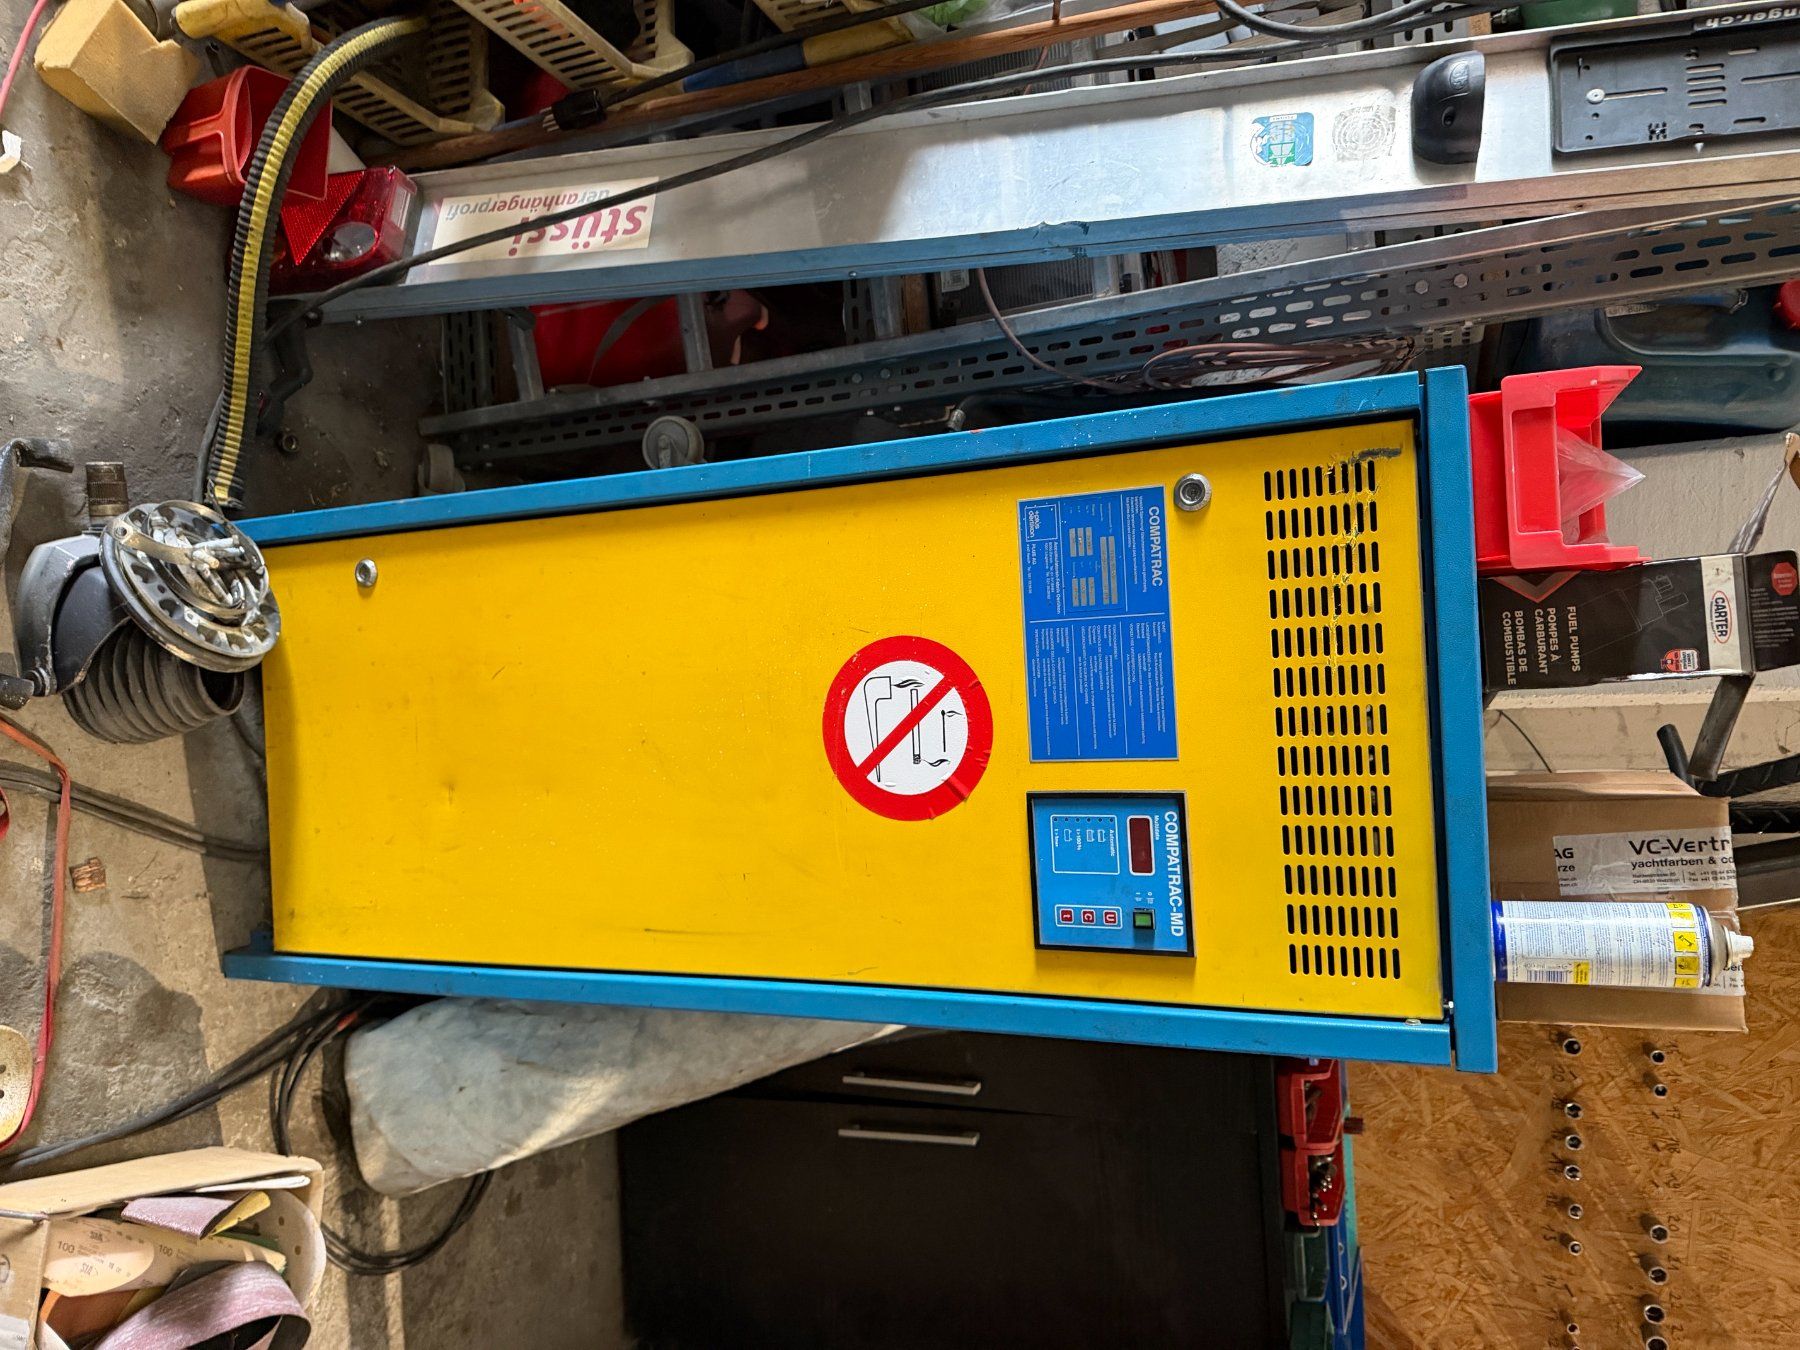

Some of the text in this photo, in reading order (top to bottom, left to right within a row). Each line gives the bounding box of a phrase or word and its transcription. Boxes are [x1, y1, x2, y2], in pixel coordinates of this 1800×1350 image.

[508, 205, 648, 257] stüssi
[1149, 506, 1163, 587] COMPATRAC
[1514, 610, 1528, 672] BOMBAS DE
[1534, 608, 1548, 675] CARBURANT
[1547, 608, 1561, 662] POMPES À
[1566, 606, 1581, 672] FUEL PUMPS
[1713, 597, 1729, 638] CARTER
[1502, 611, 1517, 685] COMBUSTIBLE
[1628, 836, 1729, 855] VC-Vertr
[1631, 858, 1703, 870] yachtfarben
[1164, 811, 1184, 936] COMPATRAC-MD
[1085, 913, 1092, 921] C
[58, 1240, 74, 1254] 100
[1668, 1215, 1681, 1232] 20
[158, 1244, 172, 1257] 100
